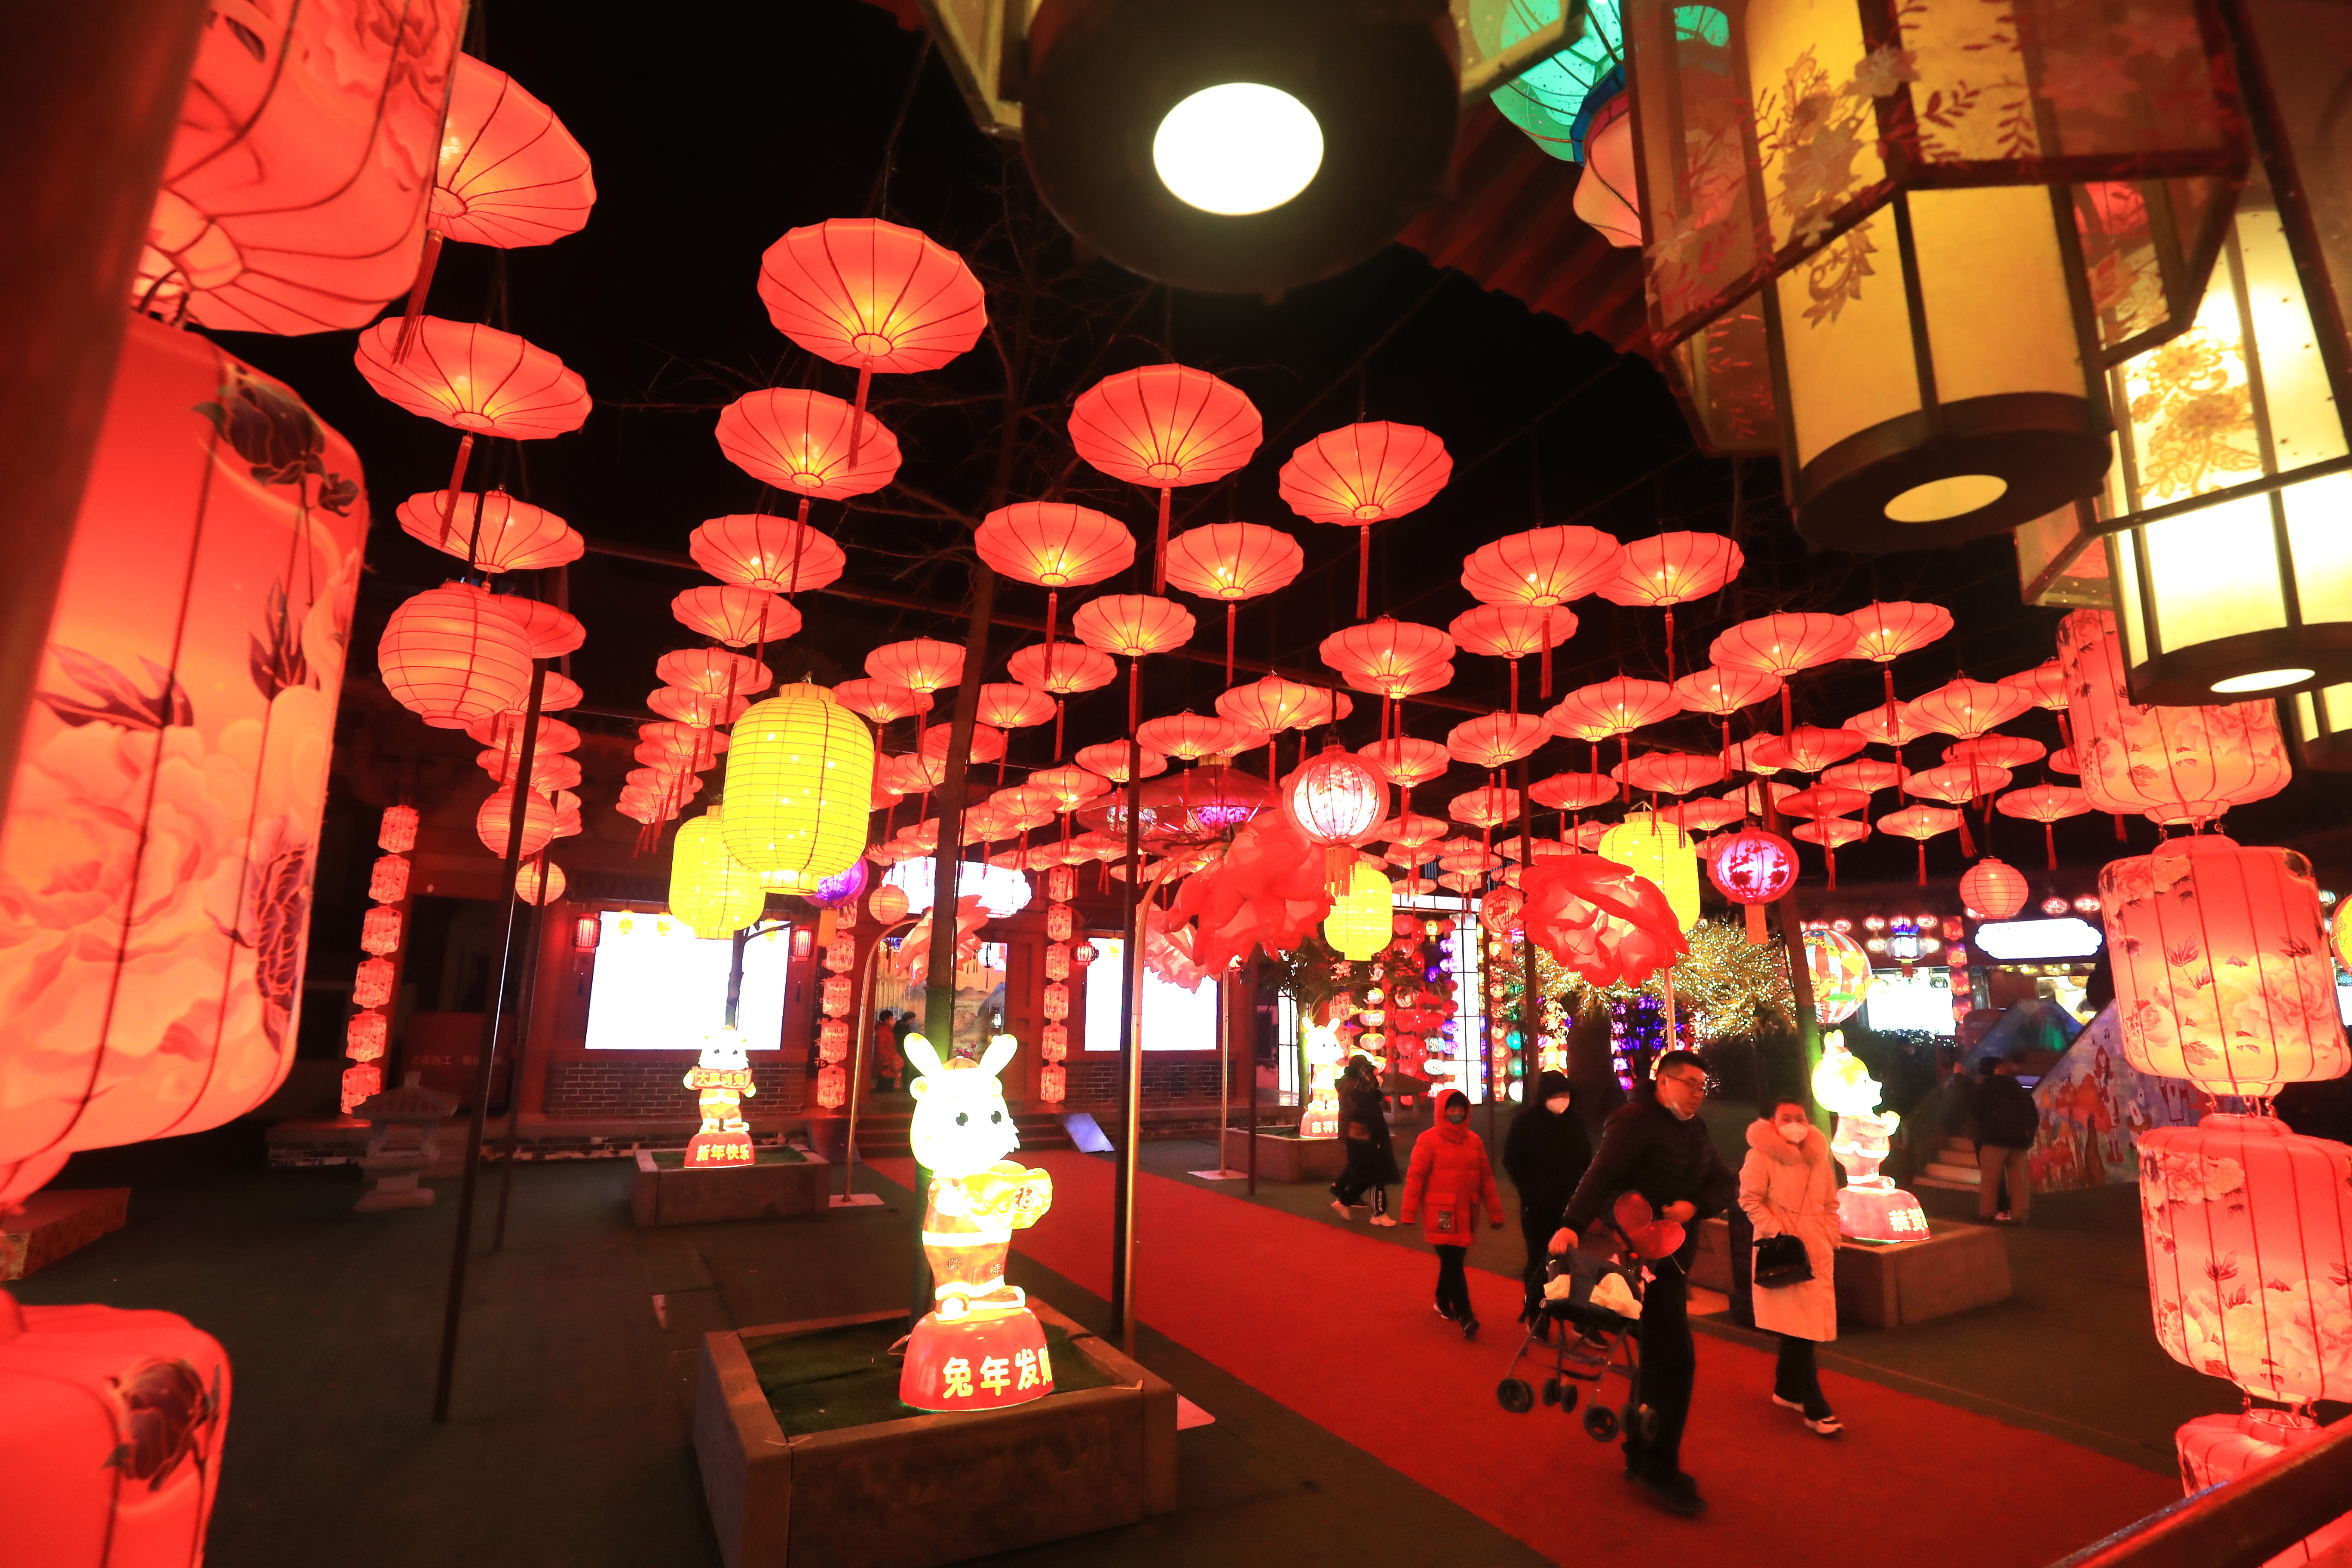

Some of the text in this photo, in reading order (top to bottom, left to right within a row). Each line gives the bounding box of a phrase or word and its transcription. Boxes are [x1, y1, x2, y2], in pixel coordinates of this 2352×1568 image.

[697, 1072, 744, 1086] 大展鸿兔
[696, 1143, 749, 1162] 新年快乐
